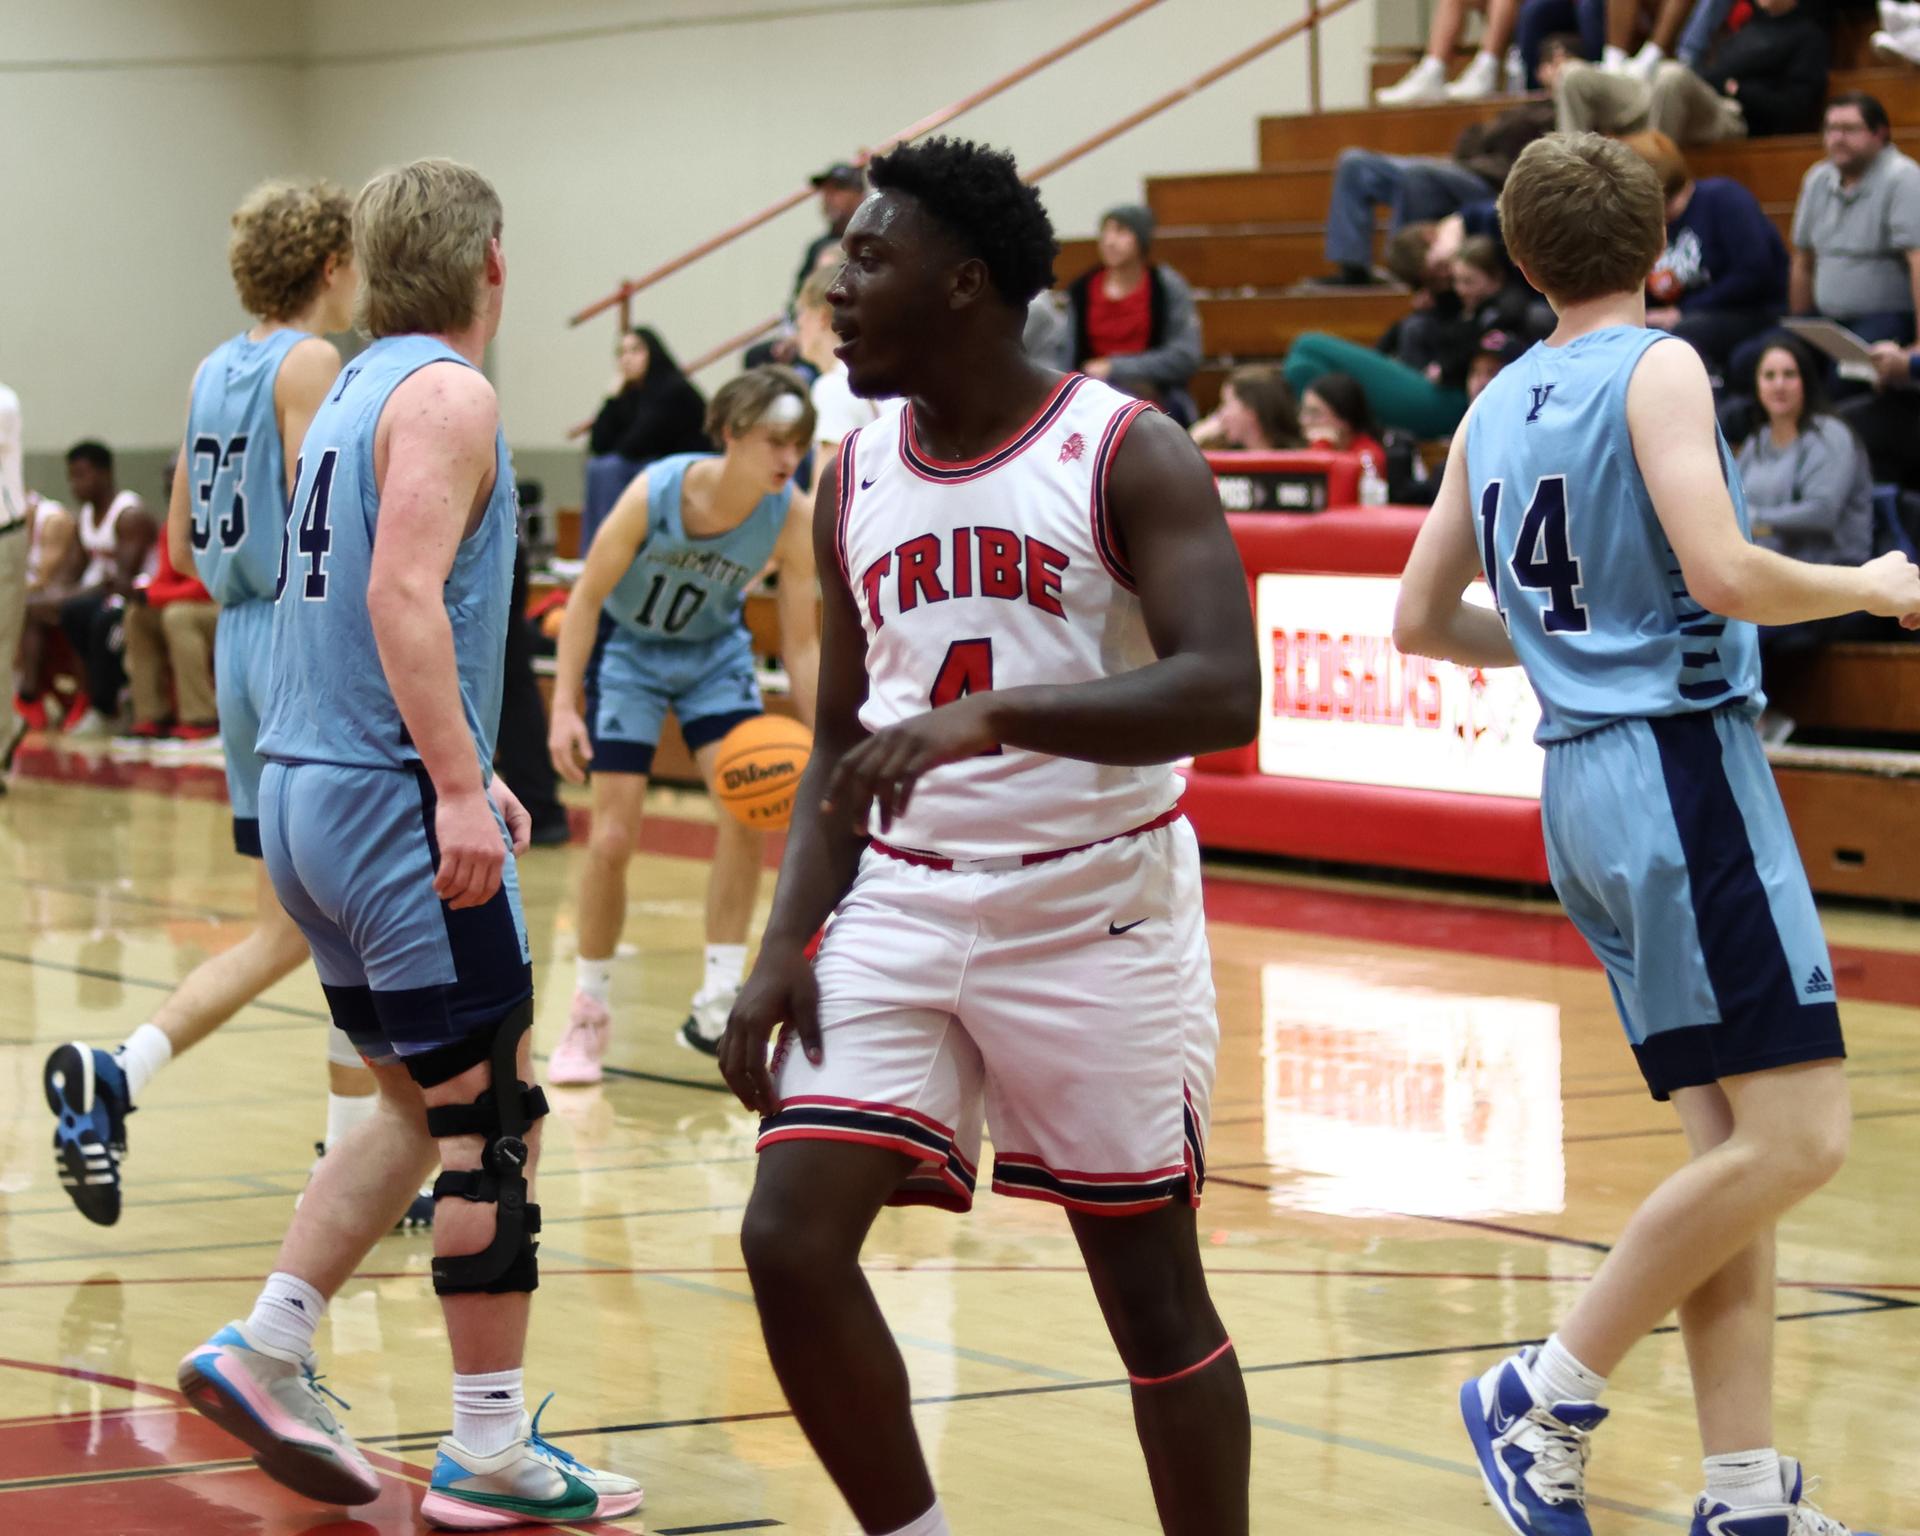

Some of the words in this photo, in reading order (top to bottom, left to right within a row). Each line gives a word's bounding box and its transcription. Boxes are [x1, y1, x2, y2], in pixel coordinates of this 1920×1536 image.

[331, 367, 363, 404] Y
[1526, 381, 1557, 424] Y
[191, 433, 248, 554] 33
[862, 526, 1070, 634] TRIBE
[1478, 473, 1591, 638] 14
[634, 573, 708, 634] 10
